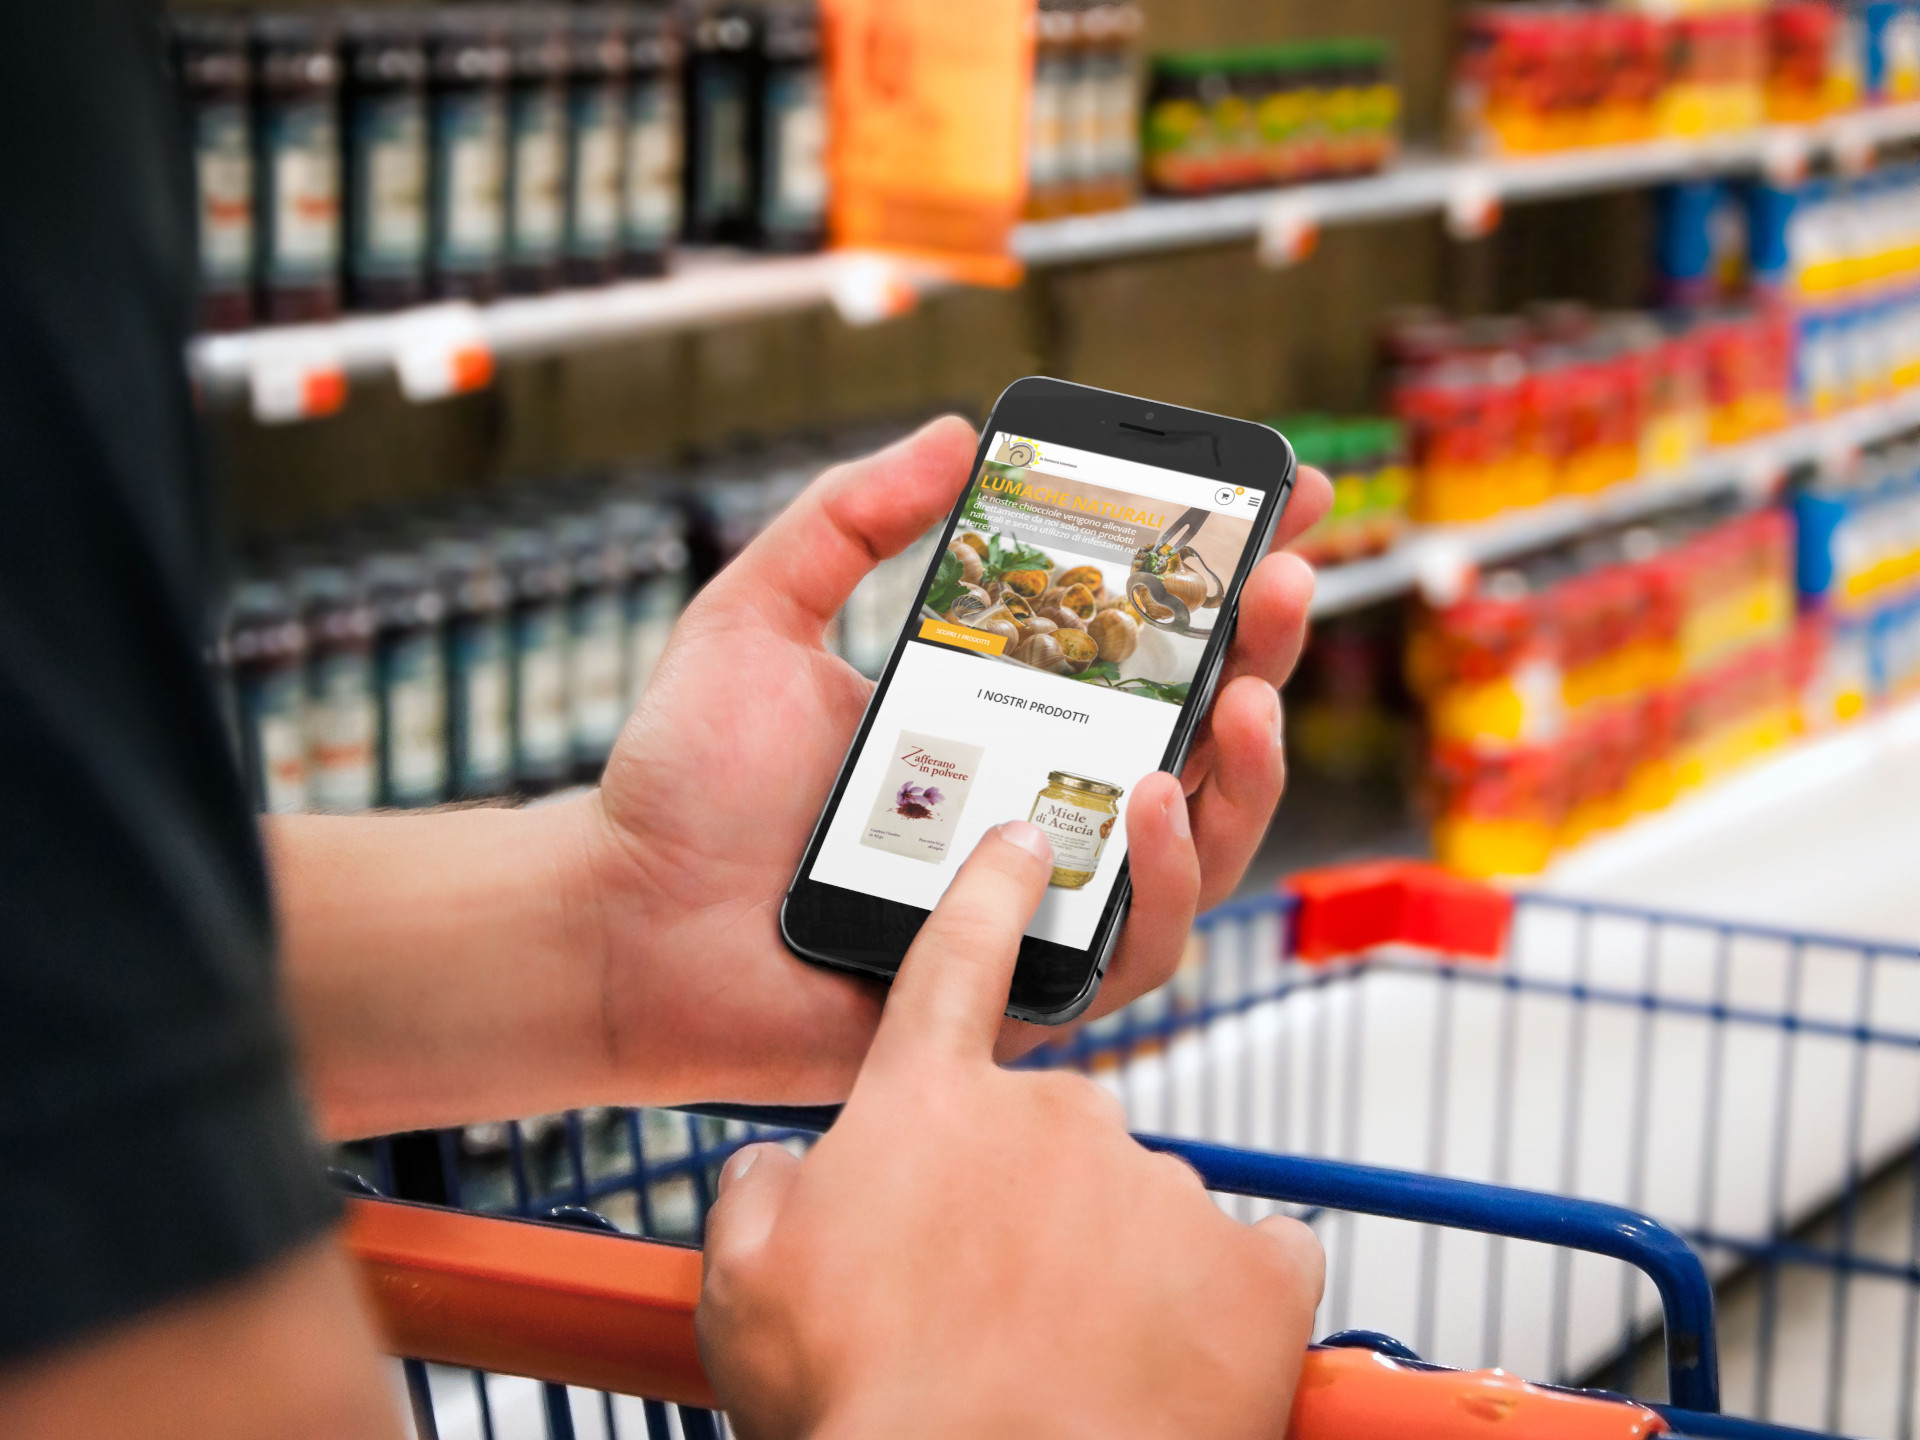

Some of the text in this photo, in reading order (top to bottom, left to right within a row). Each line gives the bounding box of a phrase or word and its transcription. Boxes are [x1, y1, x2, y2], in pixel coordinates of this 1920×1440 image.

[977, 492, 1137, 536] Le nostre chiocciole vengono allevate
[981, 475, 1165, 528] LUMACHE NATURALI
[969, 510, 1004, 524] naturali
[1012, 520, 1038, 532] senza
[1039, 525, 1070, 539] utilizzo
[1071, 532, 1081, 542] di
[1081, 535, 1124, 552] infestanti
[1124, 546, 1140, 555] nel
[973, 501, 1136, 545] direttamente da noi solo con prodotti
[935, 628, 957, 638] SCOPRI
[961, 634, 991, 646] PRODOTTI
[977, 688, 1090, 725] I NOSTRI PRODOTTI
[901, 745, 956, 770] Zafferano
[918, 763, 969, 781] in polvere
[1035, 812, 1094, 836] di Acacia
[1048, 804, 1087, 824] Miele
